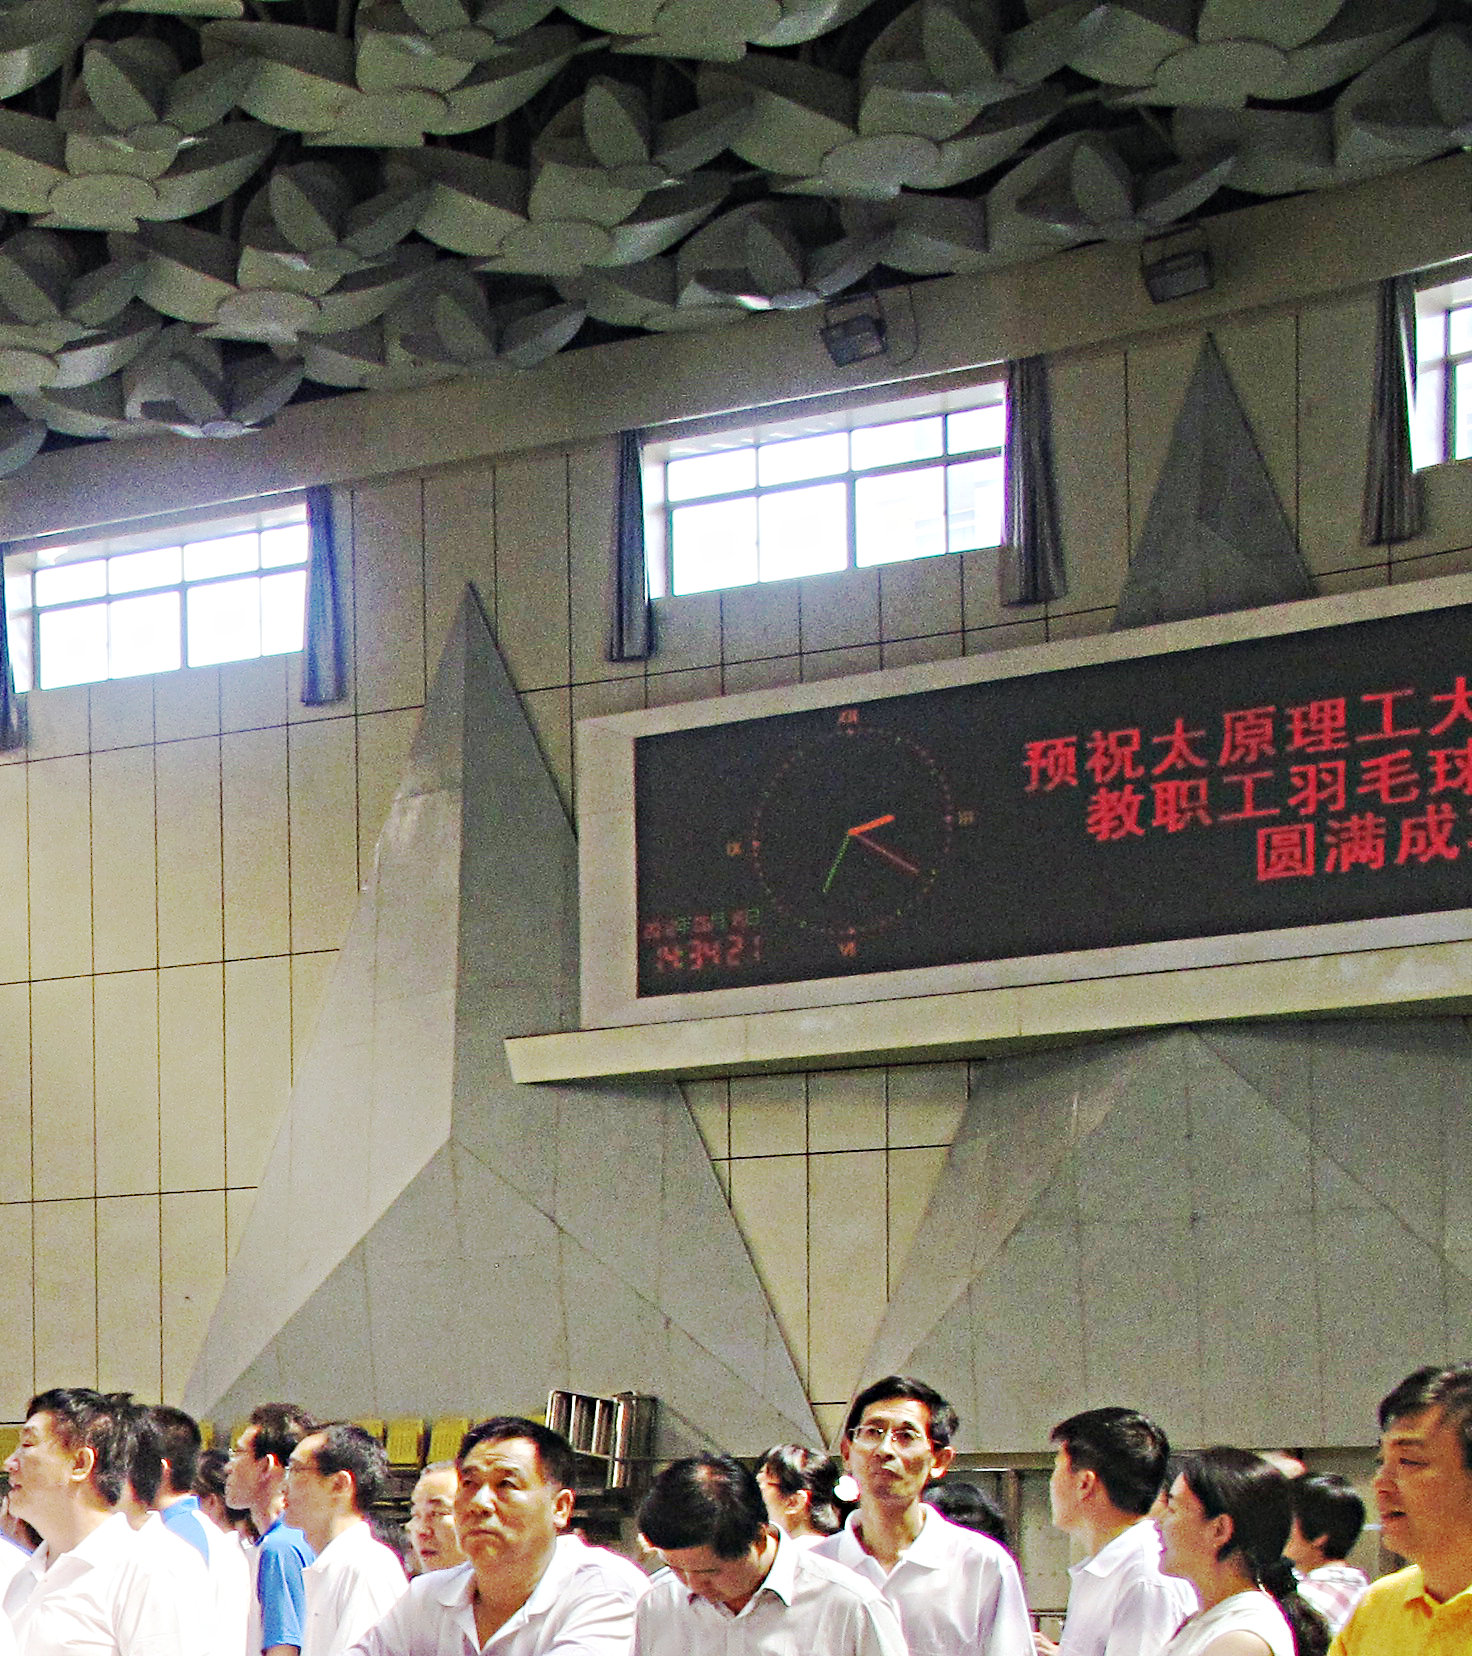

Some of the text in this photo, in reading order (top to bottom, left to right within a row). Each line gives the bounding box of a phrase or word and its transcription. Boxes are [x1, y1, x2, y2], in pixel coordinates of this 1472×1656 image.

[1024, 676, 1472, 792] 预祝太原理工大
[1087, 735, 1472, 842] 教职工羽毛球
[1256, 802, 1472, 881] 圆满成
